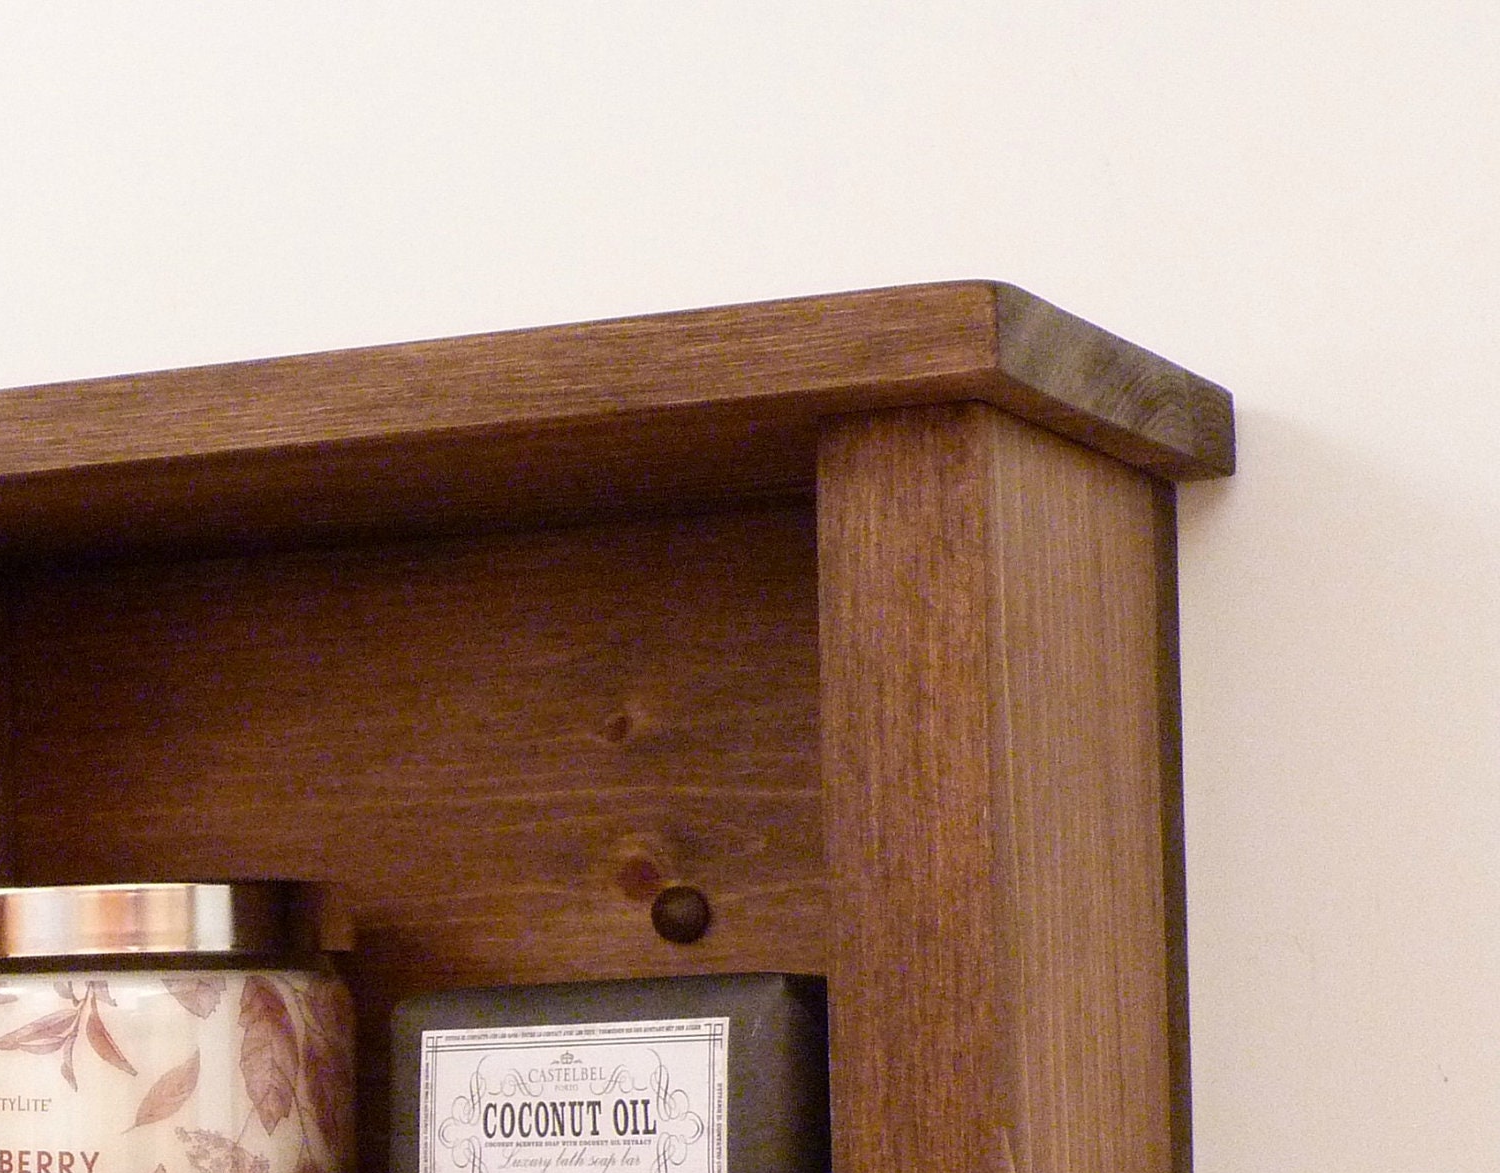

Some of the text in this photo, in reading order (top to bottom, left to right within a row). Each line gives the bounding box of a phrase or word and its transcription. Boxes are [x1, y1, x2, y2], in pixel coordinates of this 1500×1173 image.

[528, 1066, 606, 1083] CASTELBEL
[483, 1098, 657, 1139] COCONUT OIL
[555, 1146, 586, 1167] bath
[620, 1147, 641, 1163] bar
